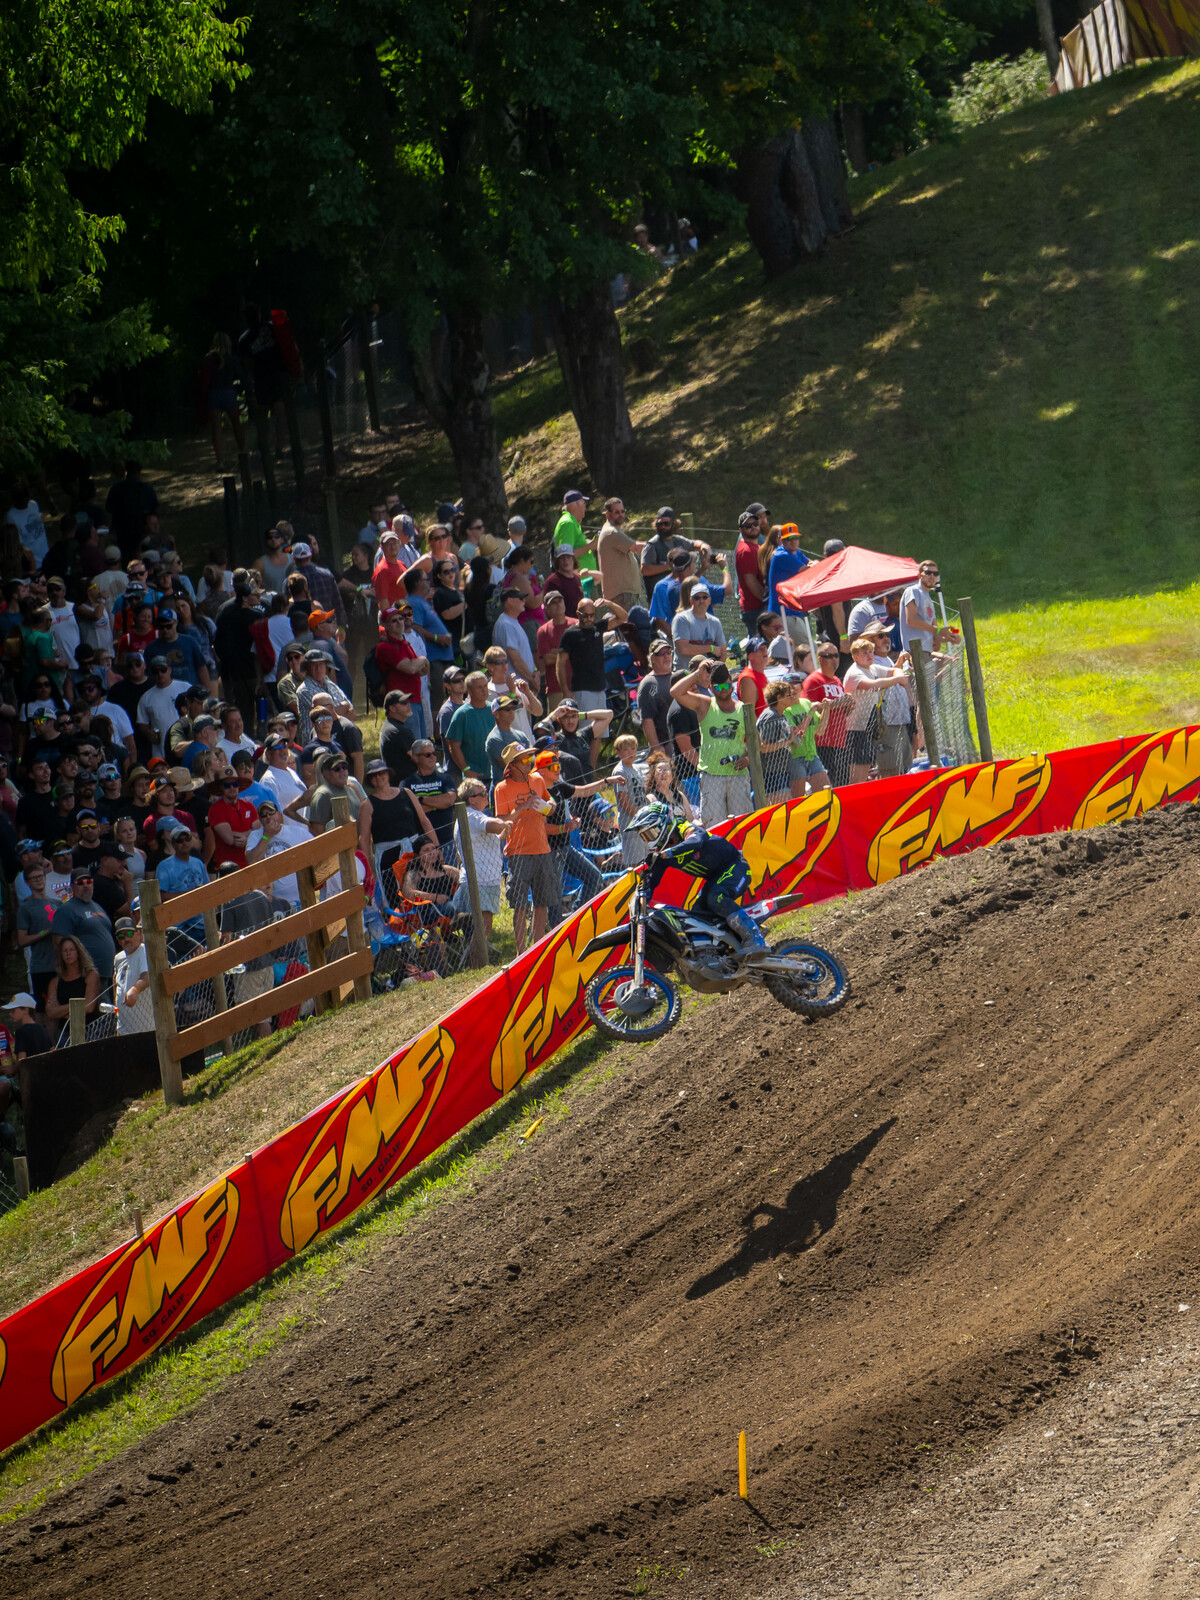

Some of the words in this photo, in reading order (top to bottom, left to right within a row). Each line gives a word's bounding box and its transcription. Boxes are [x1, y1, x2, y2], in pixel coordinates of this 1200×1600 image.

[875, 753, 1047, 886] FMF
[289, 1024, 445, 1256] FMF
[62, 1178, 230, 1405] FMF
